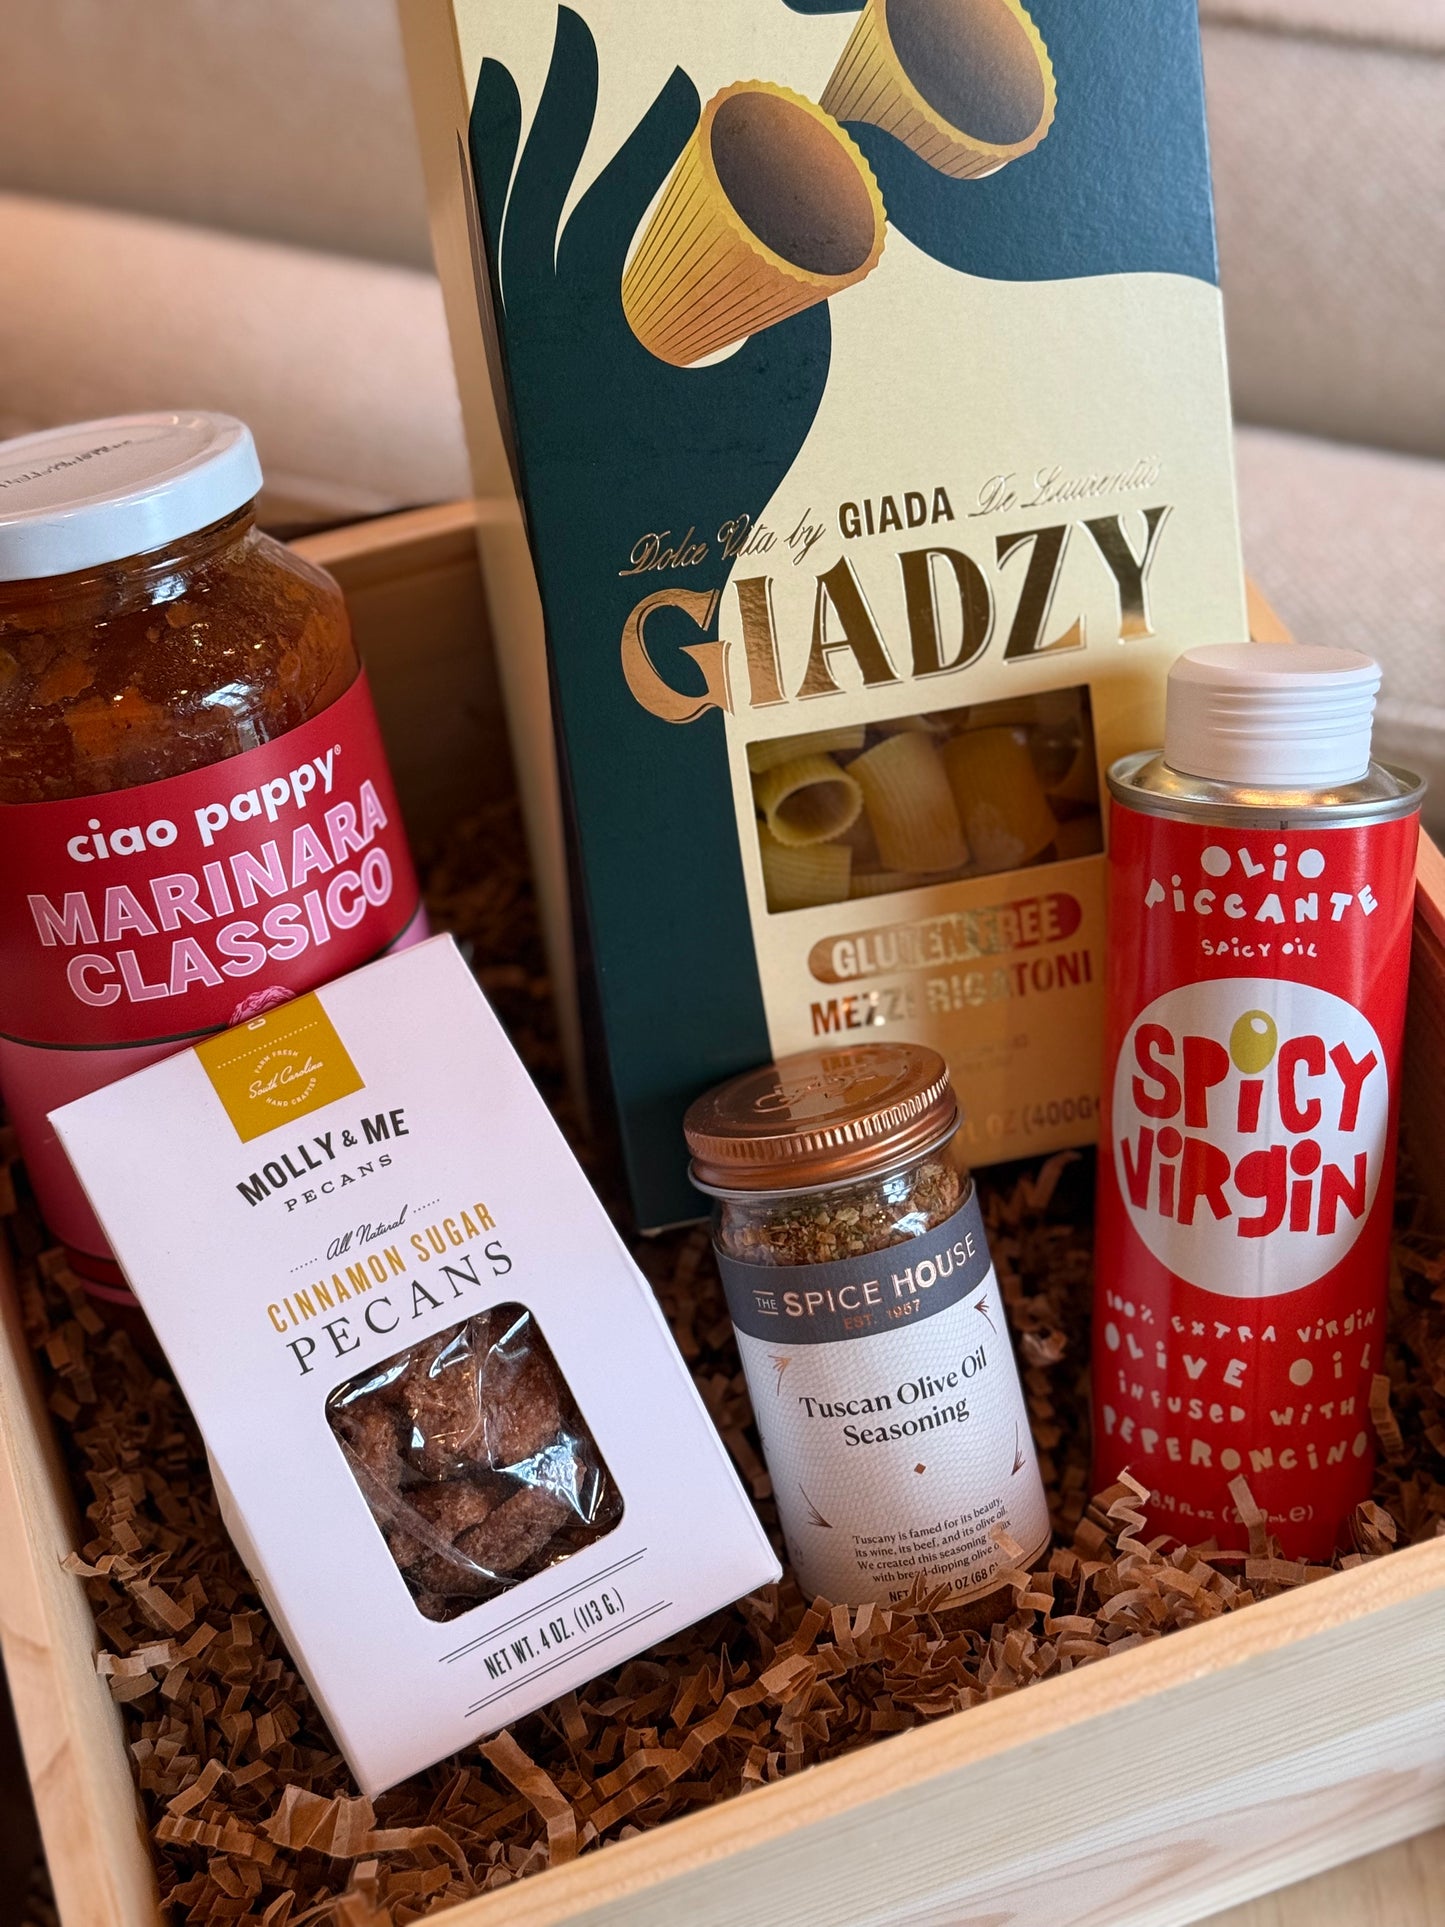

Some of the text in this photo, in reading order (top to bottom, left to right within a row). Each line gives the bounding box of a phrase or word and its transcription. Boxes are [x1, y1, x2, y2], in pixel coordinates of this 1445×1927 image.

[618, 526, 709, 576] Dolce
[717, 513, 778, 560] Vita
[784, 508, 826, 566] by
[838, 486, 956, 541] GIADA
[967, 473, 1017, 518] De
[619, 505, 1174, 725] GIADZY
[26, 779, 389, 947] MARINARA
[66, 818, 178, 863] ciao
[66, 847, 393, 1007] CLASSICO
[831, 898, 1062, 979] GLUTEN FREE
[926, 950, 1092, 1014] RIGATONI
[249, 1055, 324, 1099] South Carolina
[254, 1049, 299, 1074] FARM FRESH
[266, 1077, 317, 1107] HAND CRAFTED
[236, 1108, 409, 1207] MOLLY & ME
[284, 1153, 393, 1212] PECANS
[326, 1203, 408, 1261] All Natural
[266, 1202, 496, 1333] CINNAMON SUGAR
[755, 1231, 976, 1318] THE SPICE HOUSE
[285, 1240, 513, 1376] PECANS
[844, 1299, 921, 1331] EST. 1957
[1106, 1288, 1155, 1325] 100%
[1171, 1315, 1277, 1342] EXTRA
[799, 1345, 988, 1420] Tuscan Olive Oil
[842, 1397, 970, 1447] Seasoning
[852, 1496, 1004, 1546] Tuscany is famed for its beauty,
[855, 1548, 867, 1558] its
[869, 1546, 897, 1557] wine,
[899, 1544, 912, 1554] its
[913, 1537, 940, 1550] beef,
[941, 1530, 960, 1546] and
[962, 1527, 974, 1538] its
[975, 1515, 996, 1532] olive
[996, 1505, 1009, 1519] oil.
[857, 1560, 875, 1571] We
[876, 1556, 916, 1570] created
[918, 1552, 938, 1565] this
[939, 1533, 987, 1560] seasoning
[872, 1571, 895, 1583] with
[897, 1556, 970, 1582] bred-dipping
[971, 1546, 992, 1562] olive
[955, 1576, 970, 1589] OZ
[970, 1568, 988, 1584] (68
[483, 1586, 625, 1680] NET WT. 4 OZ. (113 G.)
